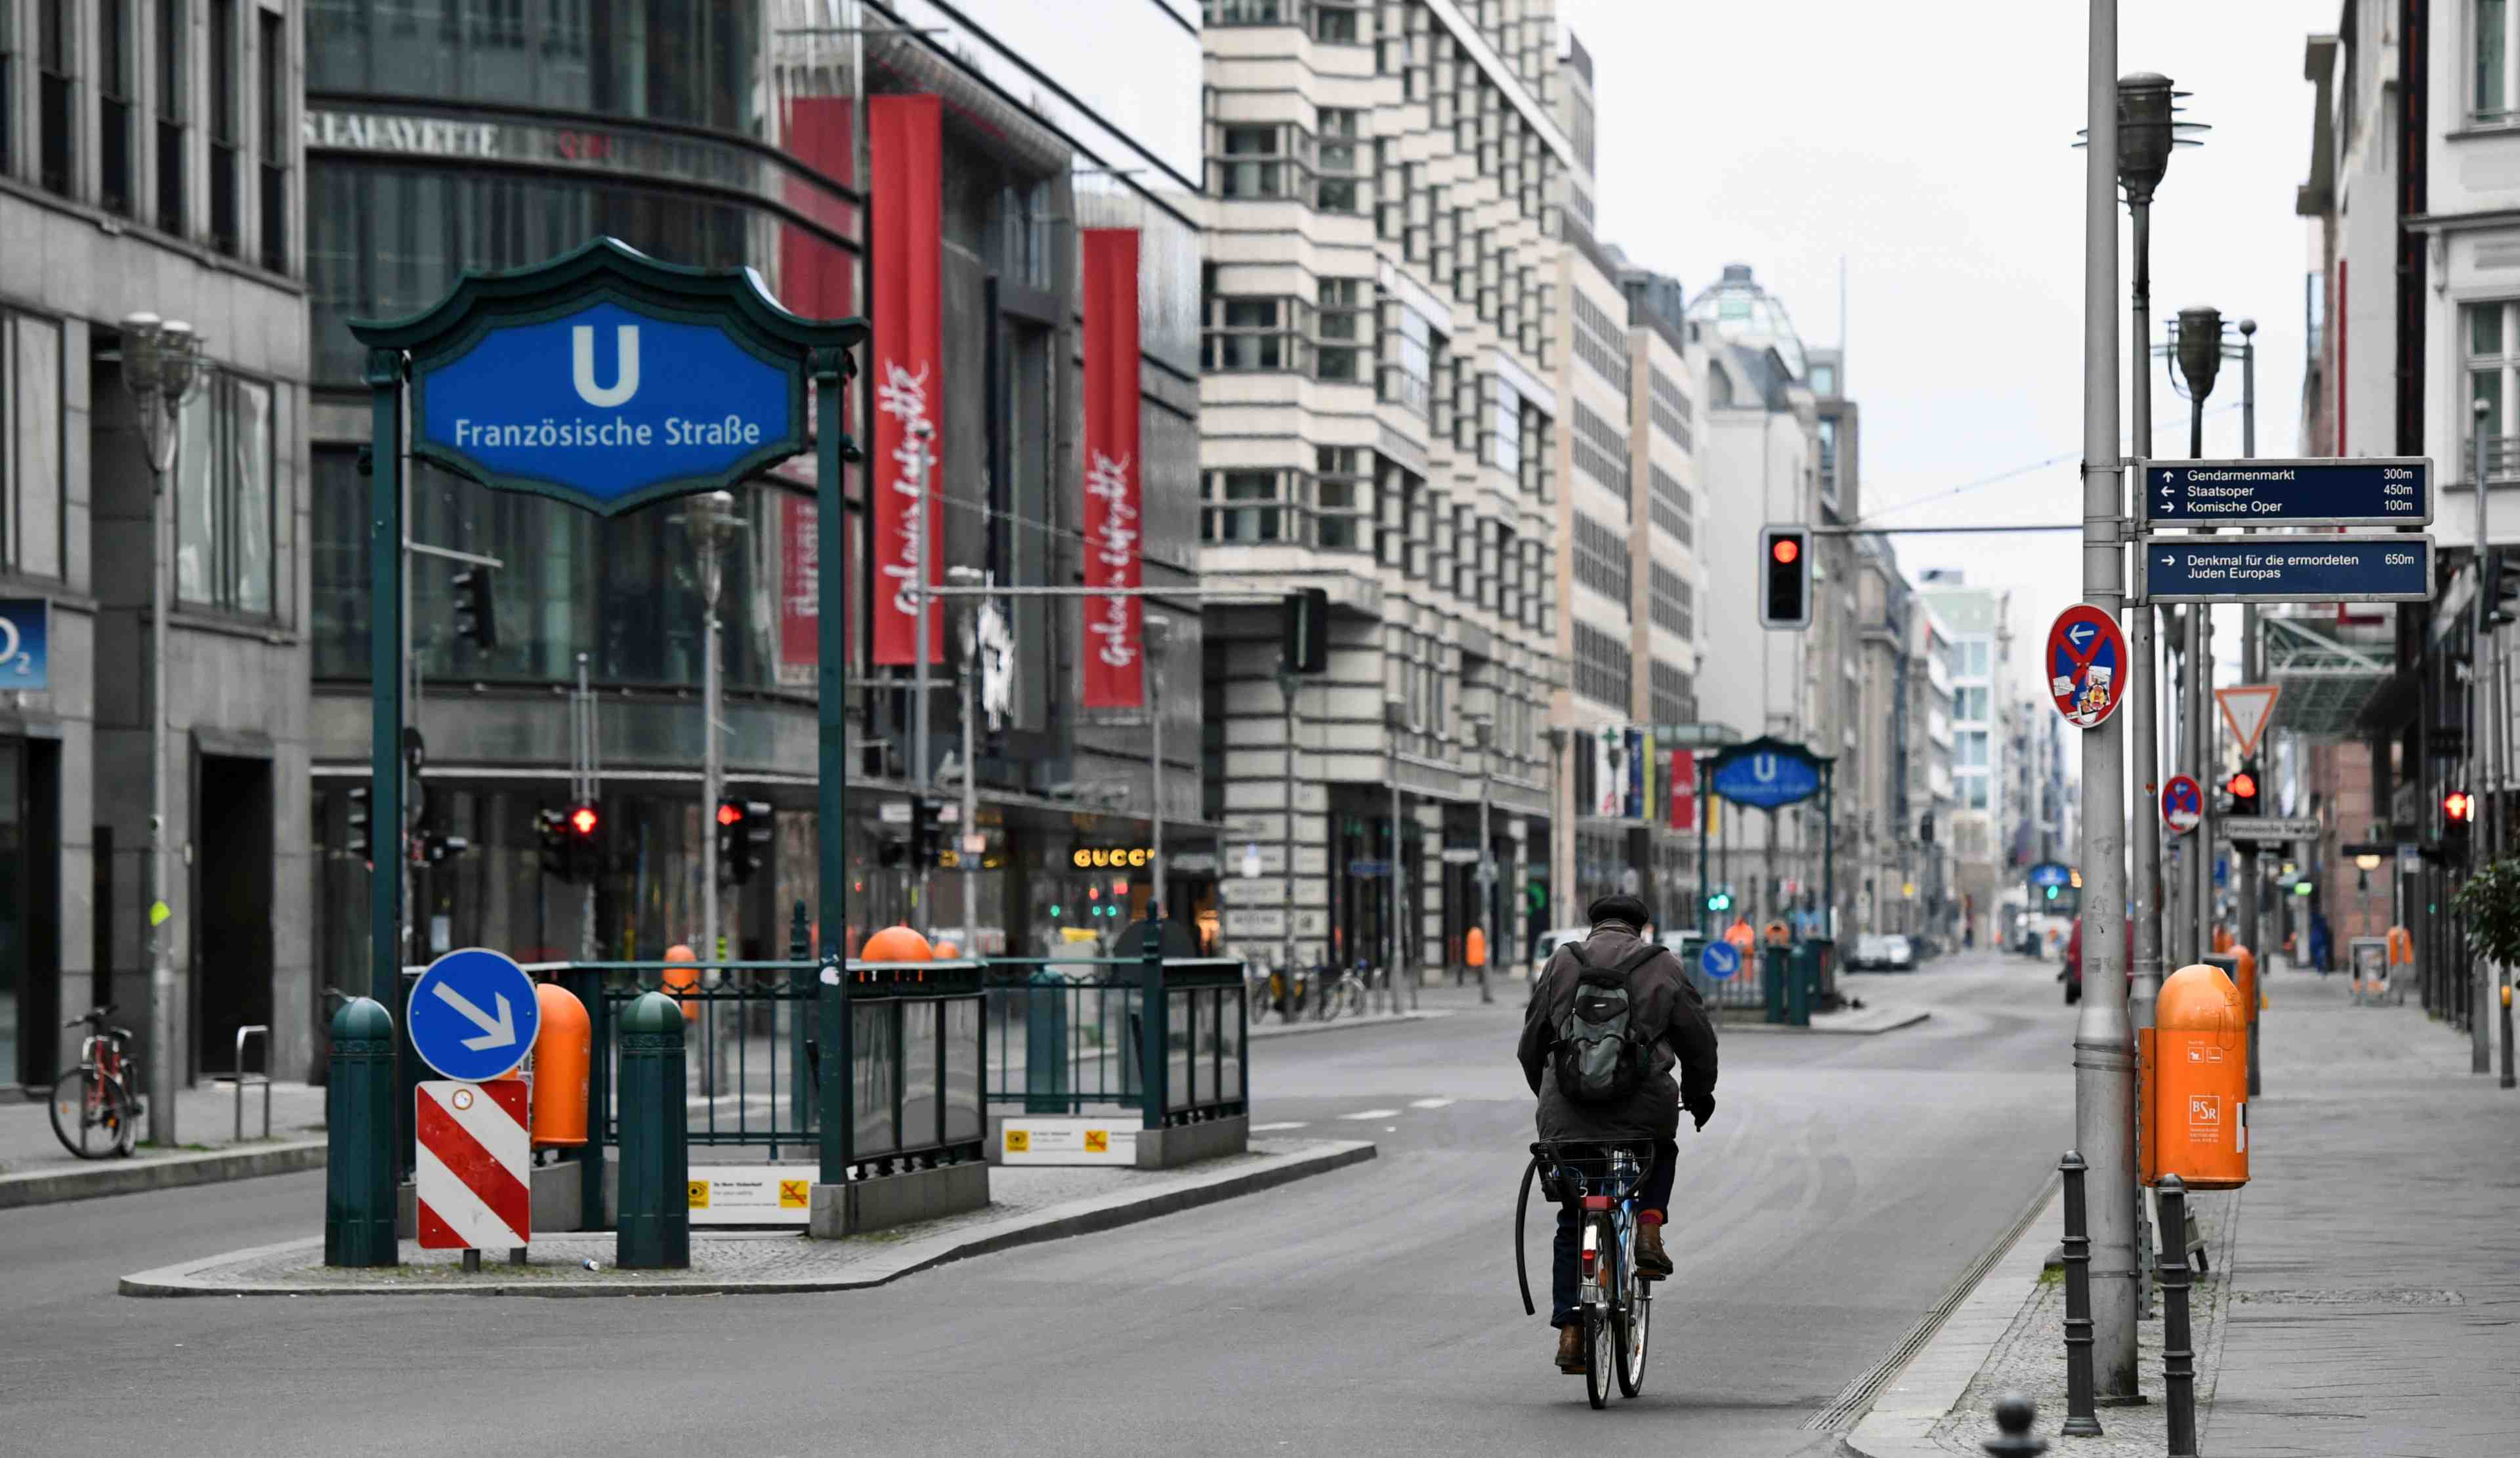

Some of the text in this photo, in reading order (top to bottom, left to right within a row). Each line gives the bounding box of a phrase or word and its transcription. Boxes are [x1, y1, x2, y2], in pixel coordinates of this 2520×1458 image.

[572, 325, 640, 407] U
[455, 415, 760, 447] Französische Straße
[2187, 469, 2413, 481] Gendarmenmarkt 300m
[2187, 485, 2413, 499] Staatsoper 450m
[2187, 501, 2413, 514] Komische Oper 100m
[2188, 554, 2414, 566] Denkmal für die ermordeten 650m
[2188, 568, 2281, 581] Juden Europas
[1754, 753, 1776, 782] U
[2193, 1100, 2216, 1119] BSR
